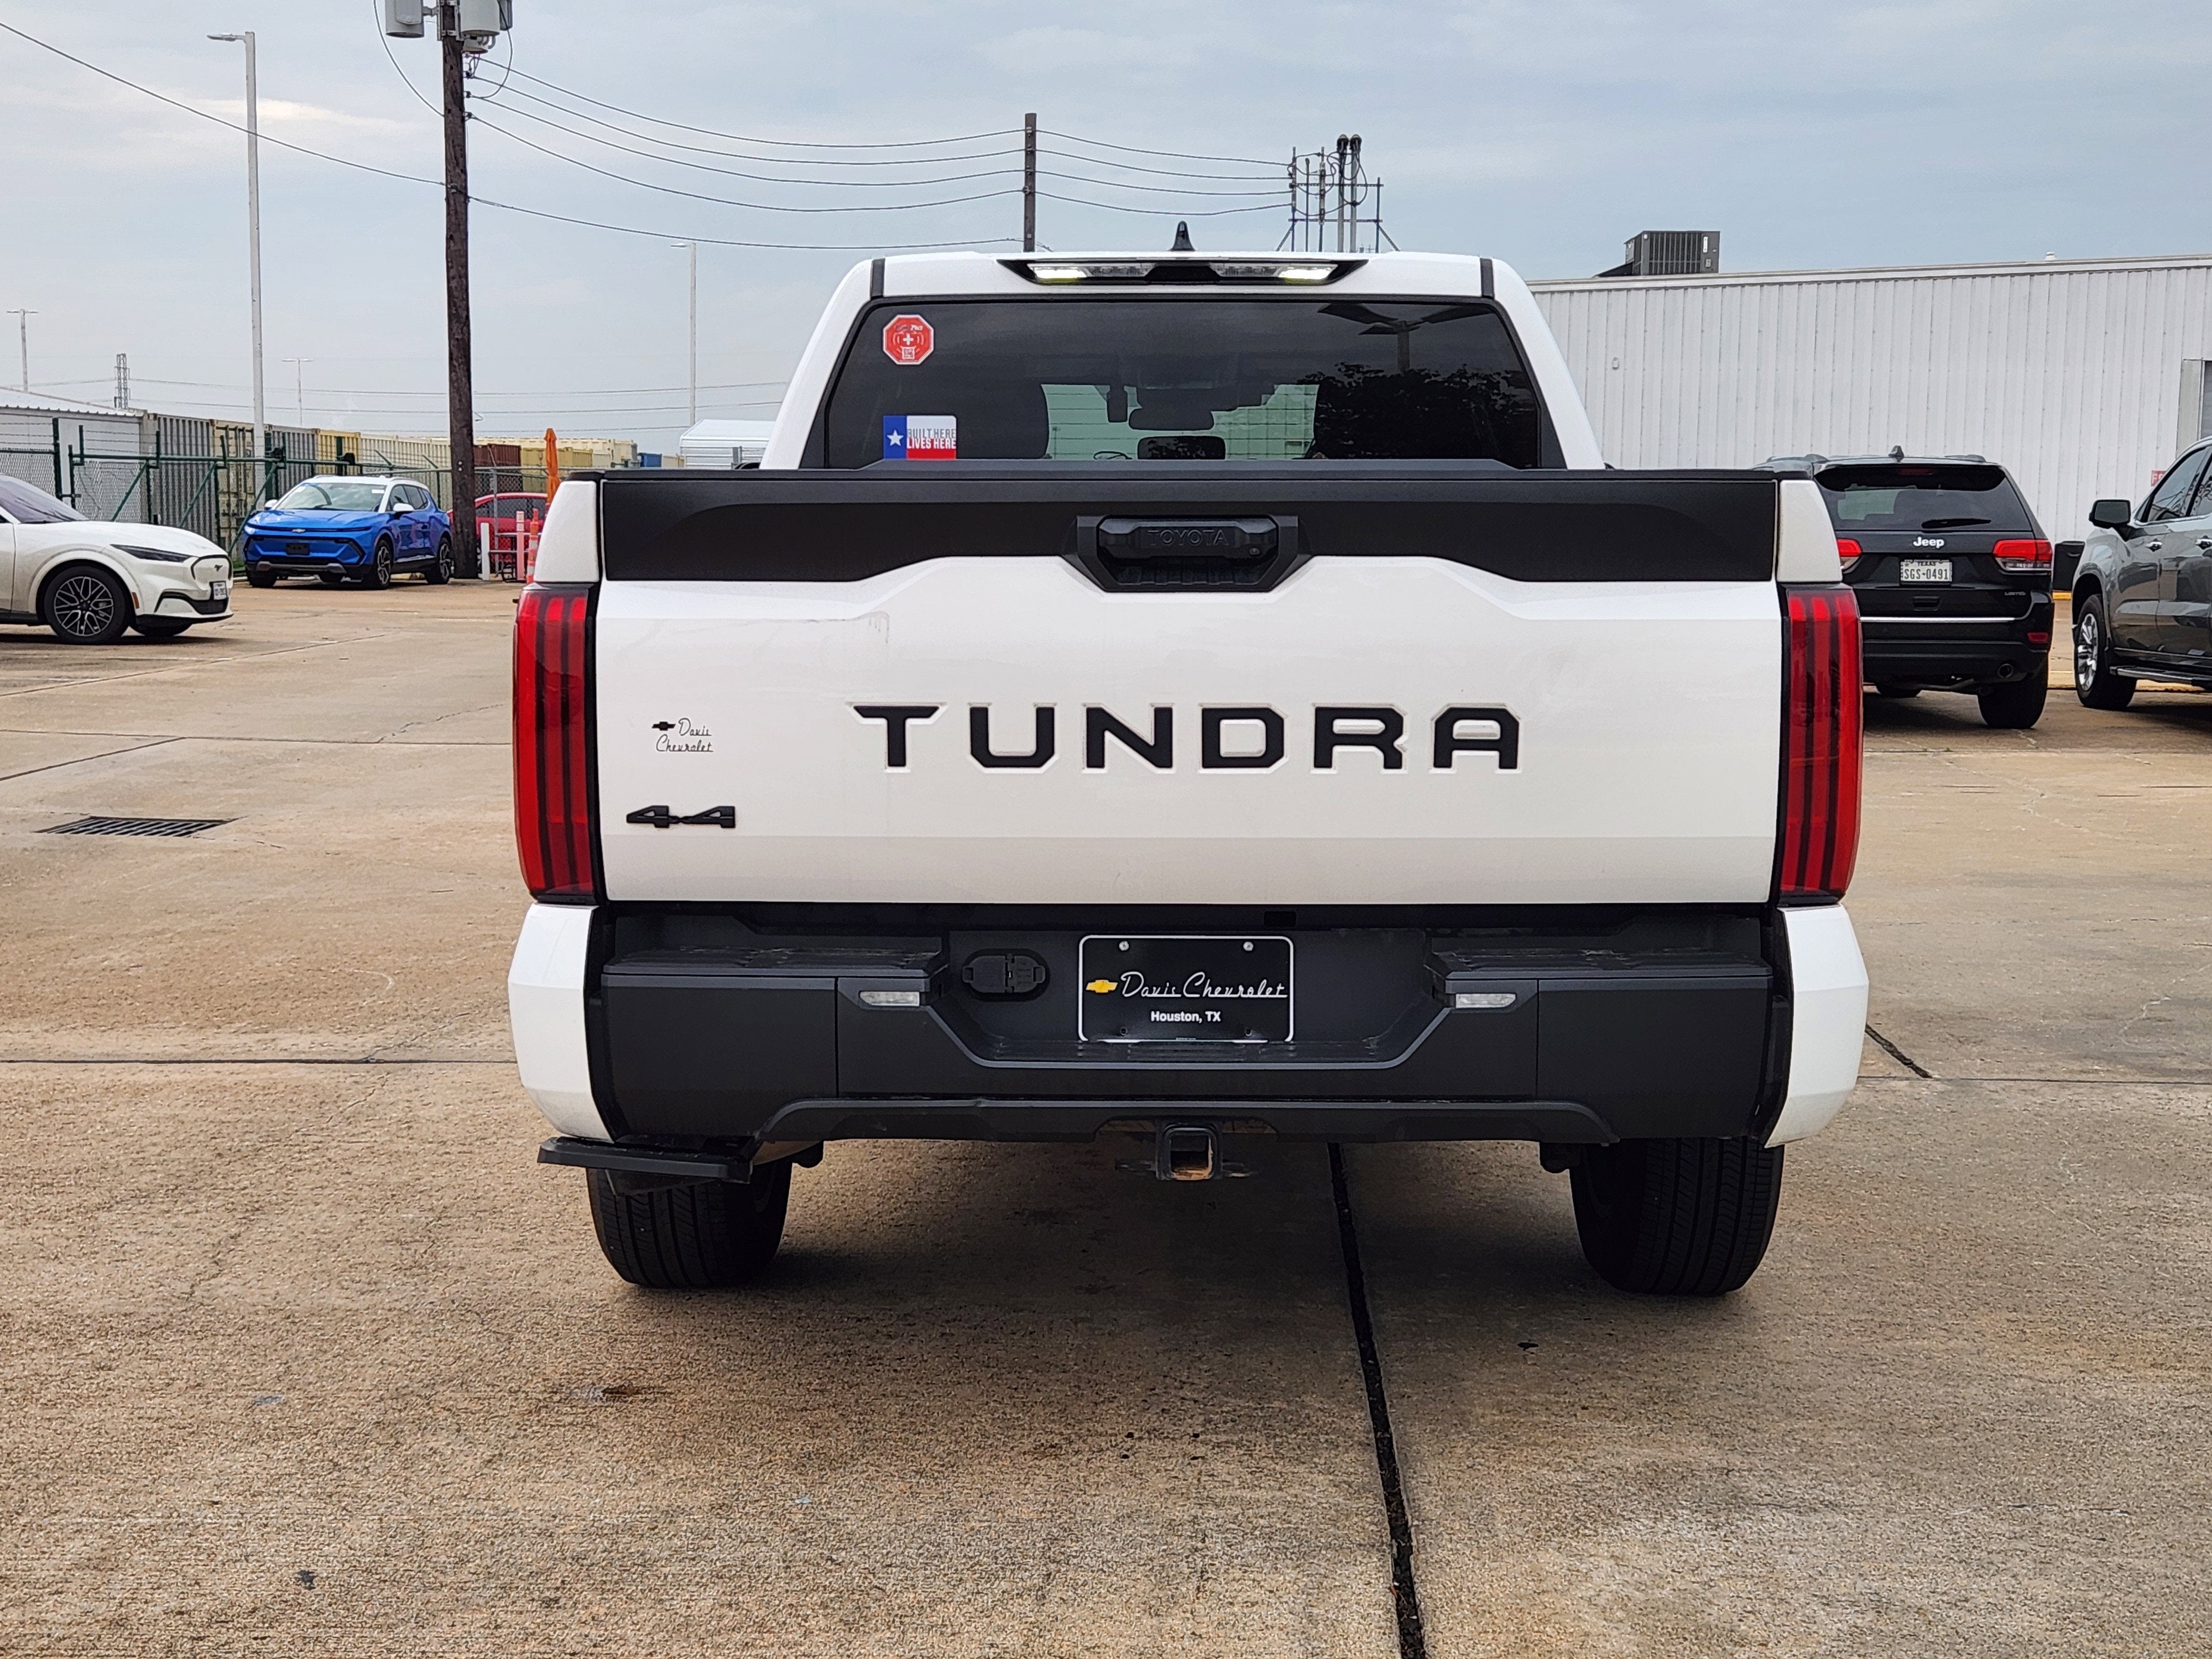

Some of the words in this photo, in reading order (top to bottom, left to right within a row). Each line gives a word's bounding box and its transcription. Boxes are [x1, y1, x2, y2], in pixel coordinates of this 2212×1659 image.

[933, 428, 956, 439] HERE
[907, 438, 931, 449] LIVES
[933, 438, 956, 449] HERE
[1147, 530, 1229, 546] TOYOTA
[1913, 536, 1944, 549] Jeep
[678, 717, 712, 736] Davis
[656, 734, 714, 753] Chevrolet
[851, 703, 1521, 770] TUNDRA
[1120, 971, 1182, 998] Davis
[1183, 971, 1288, 998] Chevrolet
[1151, 1011, 1203, 1024] Houston,
[1204, 1011, 1221, 1022] TX
